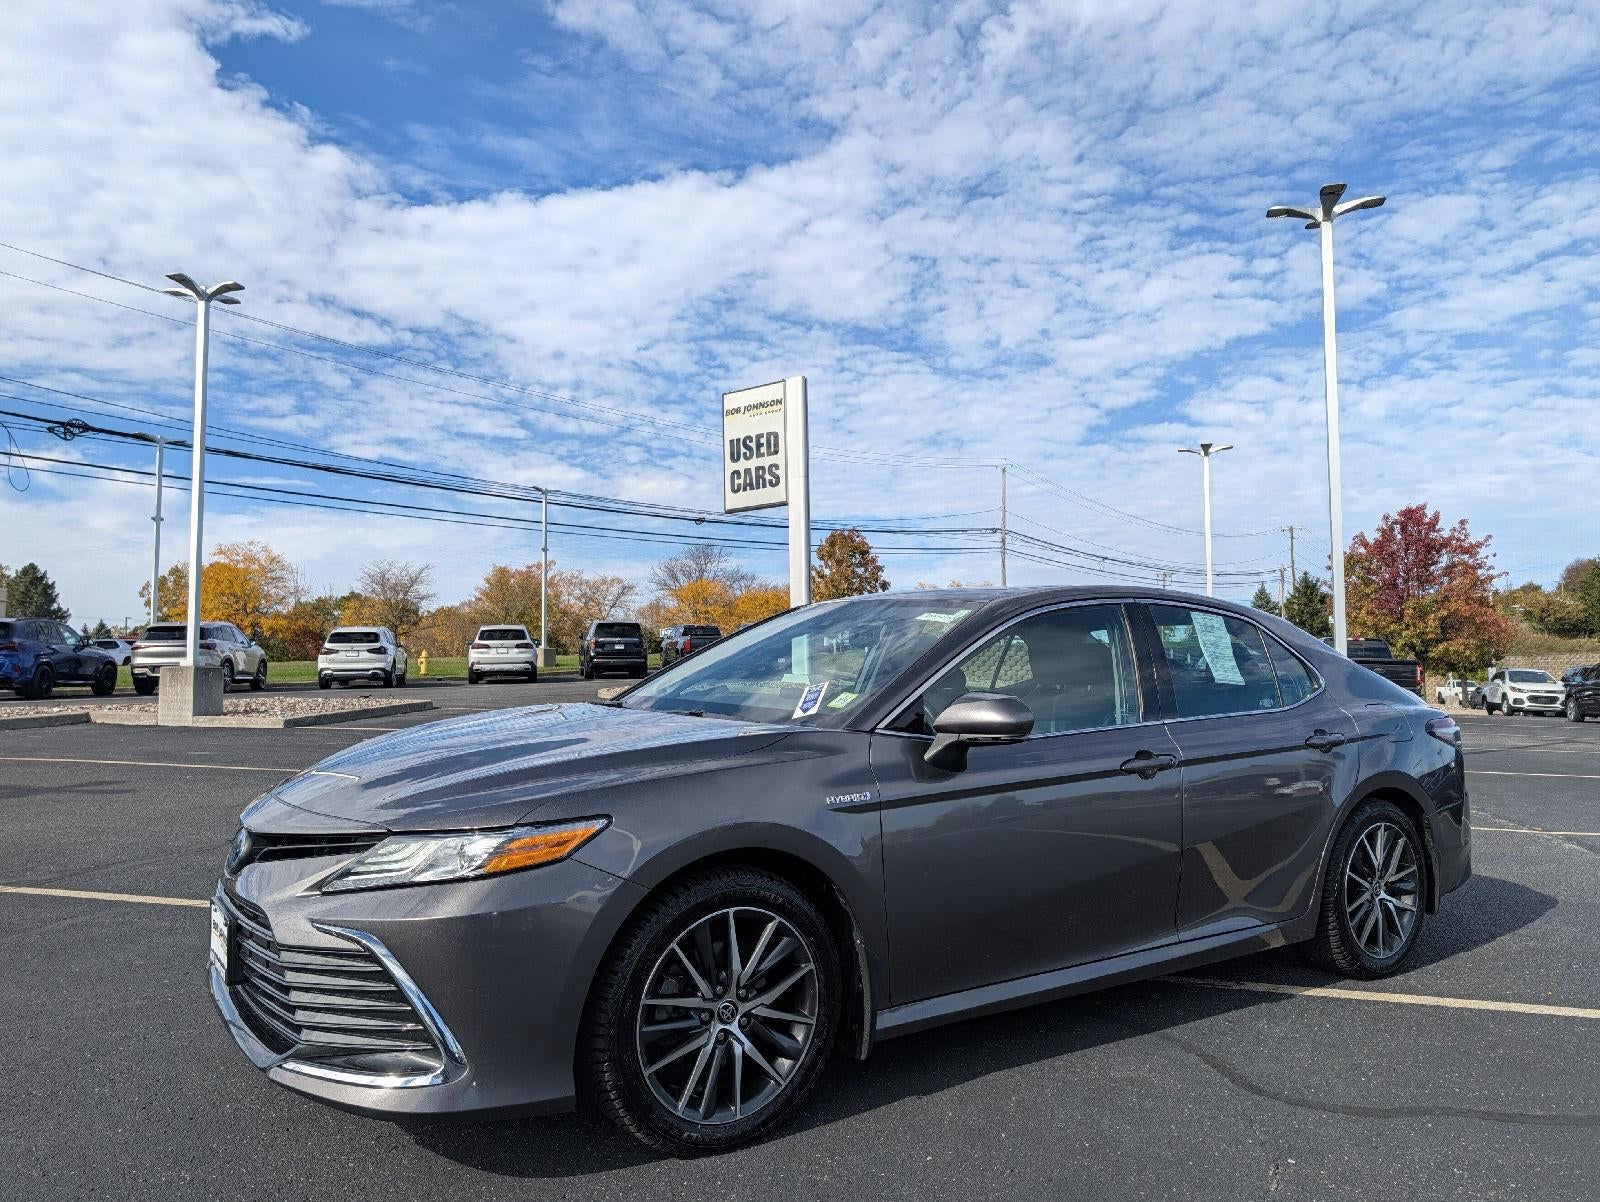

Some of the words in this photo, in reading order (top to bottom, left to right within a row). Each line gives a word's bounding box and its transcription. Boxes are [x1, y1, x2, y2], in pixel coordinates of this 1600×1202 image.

[725, 407, 742, 417] BOB
[743, 398, 783, 415] JOHNSON
[729, 431, 780, 464] USED
[730, 463, 781, 495] CARS
[826, 792, 869, 805] HYBRID
